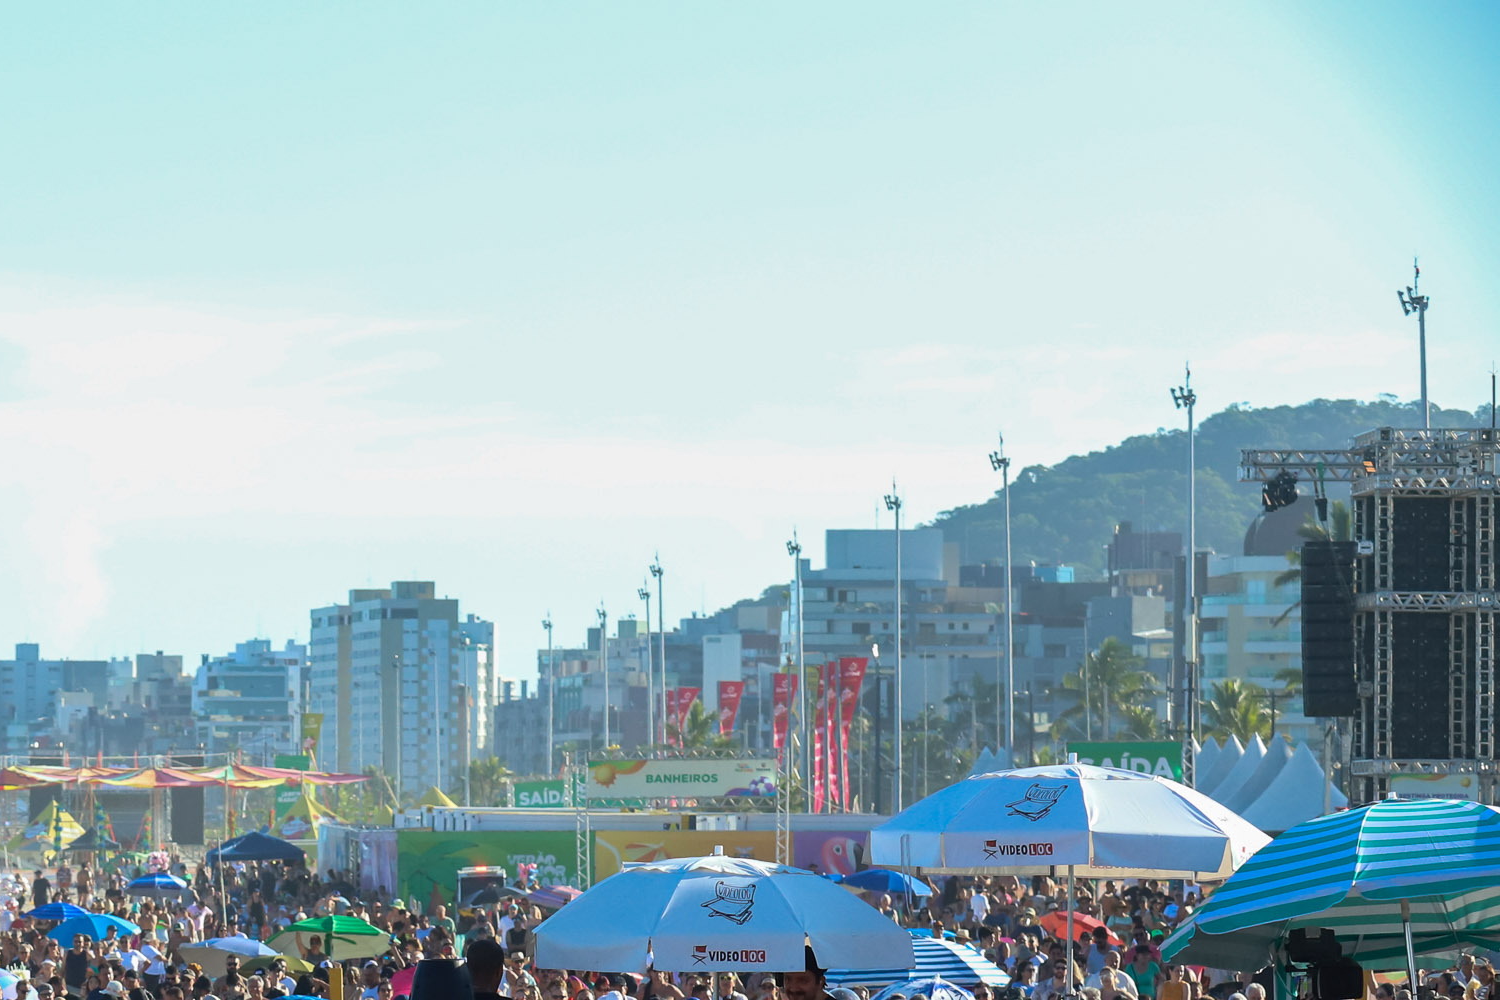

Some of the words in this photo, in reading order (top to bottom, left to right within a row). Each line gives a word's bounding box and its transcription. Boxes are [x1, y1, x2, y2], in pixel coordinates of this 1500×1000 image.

[1080, 752, 1175, 779] AÍDA
[646, 773, 718, 784] BANHEIROS
[999, 843, 1053, 856] VIDEOLOC
[708, 950, 766, 962] VIDEOLOC
